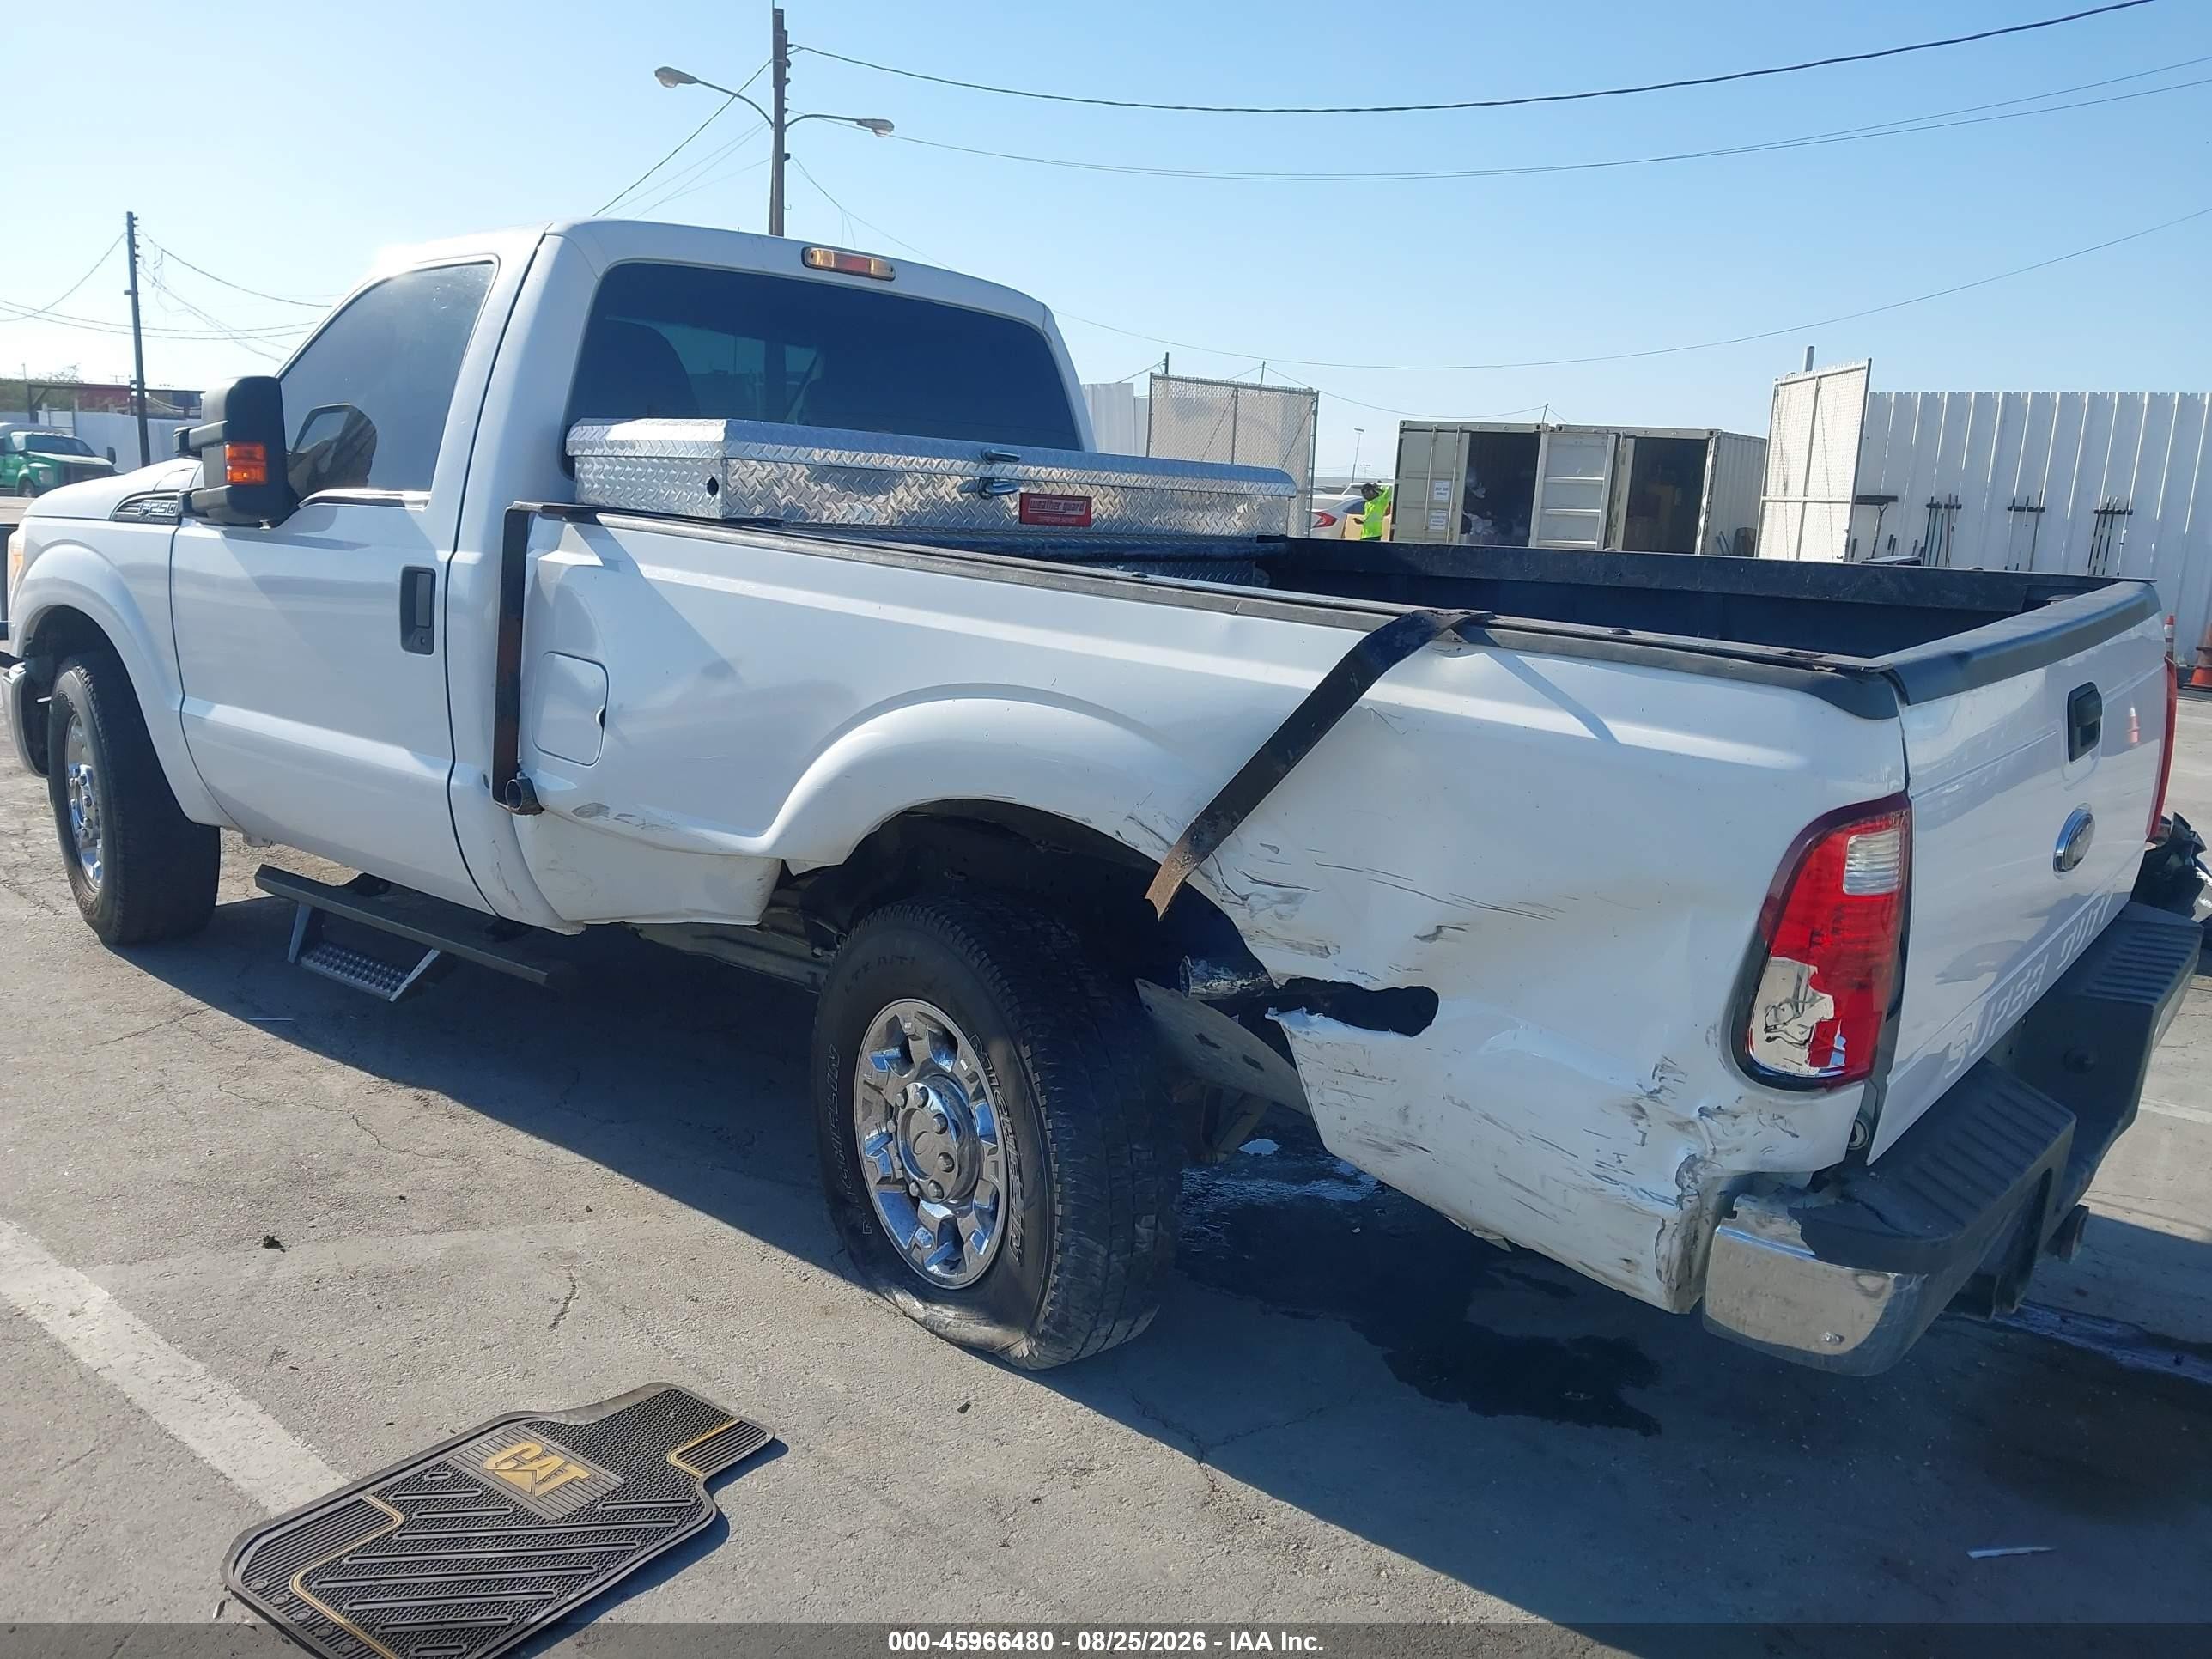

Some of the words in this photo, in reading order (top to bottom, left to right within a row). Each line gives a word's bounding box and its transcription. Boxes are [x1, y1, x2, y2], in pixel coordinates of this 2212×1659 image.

[1945, 953, 2049, 1079] SUPER
[969, 1034, 1025, 1265] MICHELIN
[482, 1442, 592, 1498] CAT
